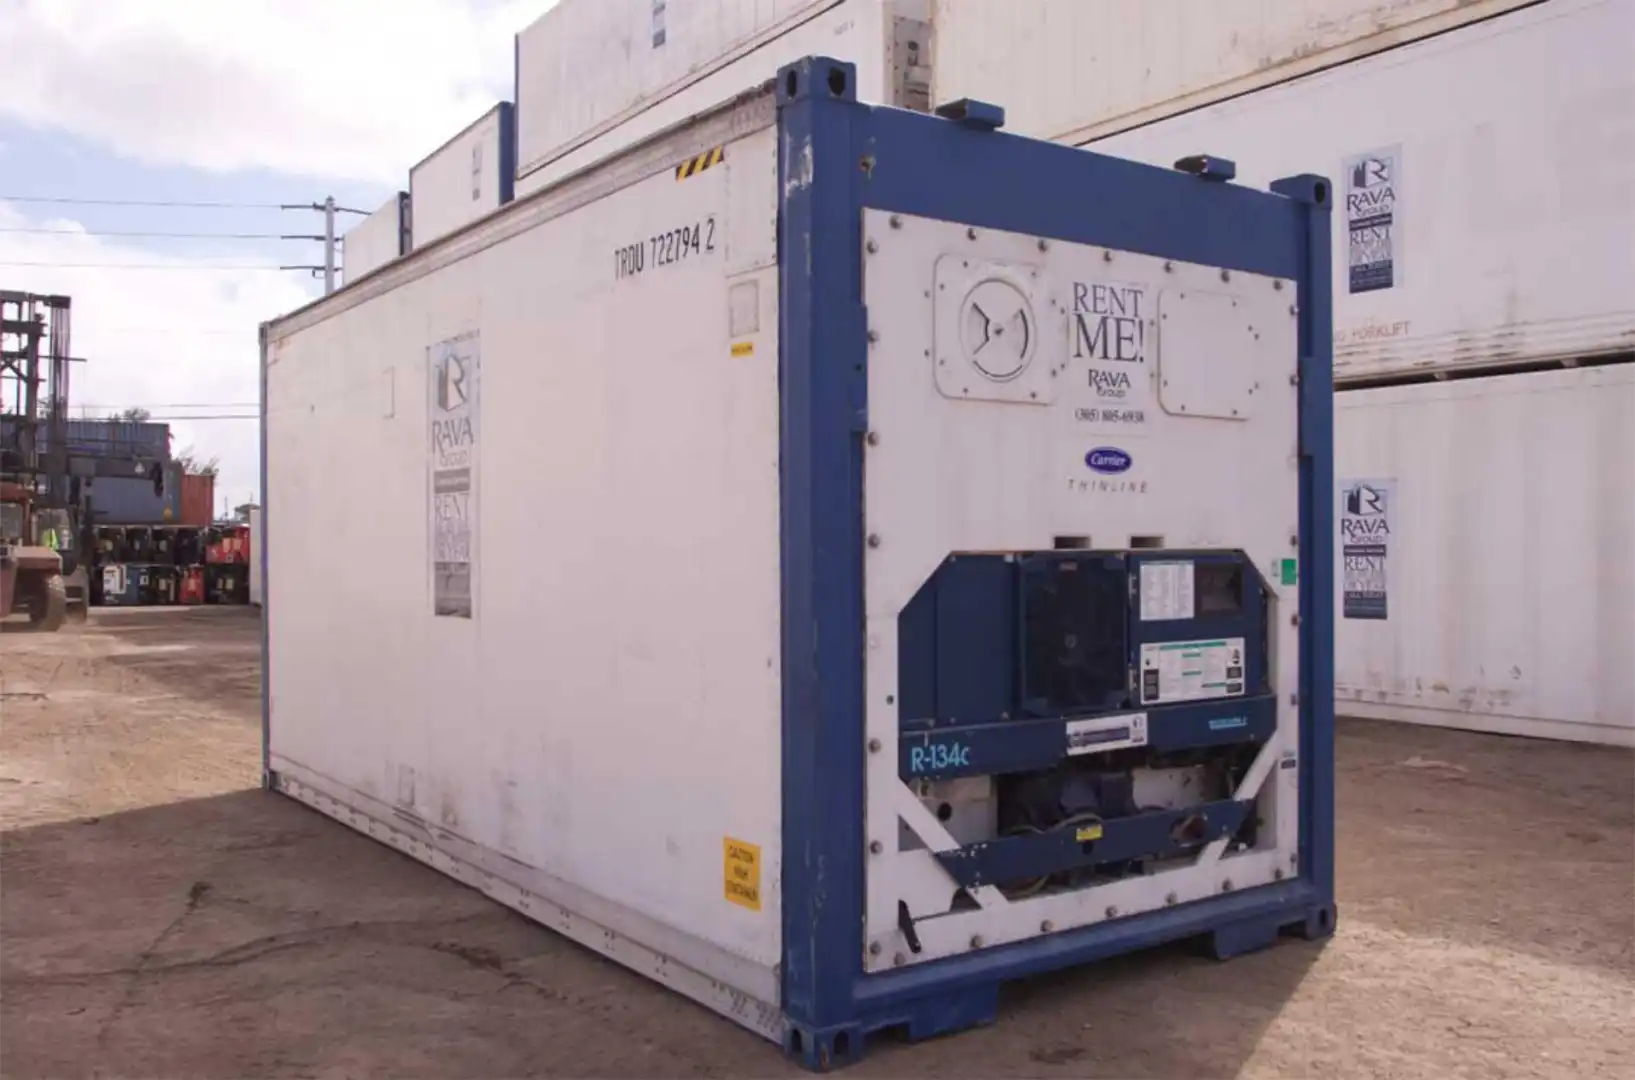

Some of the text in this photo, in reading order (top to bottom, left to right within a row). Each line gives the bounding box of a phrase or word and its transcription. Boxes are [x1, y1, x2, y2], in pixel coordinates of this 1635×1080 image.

[1346, 187, 1395, 213] RAVA
[614, 218, 715, 281] TRDU 722794 2
[1349, 226, 1391, 247] RENT
[1072, 281, 1144, 318] RENT
[1073, 313, 1145, 362] ME!
[1088, 368, 1132, 390] RAVA
[432, 415, 475, 456] RAVA
[1067, 478, 1148, 494] THINLINE
[434, 493, 470, 526] RENT
[1341, 518, 1390, 538] RAVA
[1343, 555, 1384, 573] RENT
